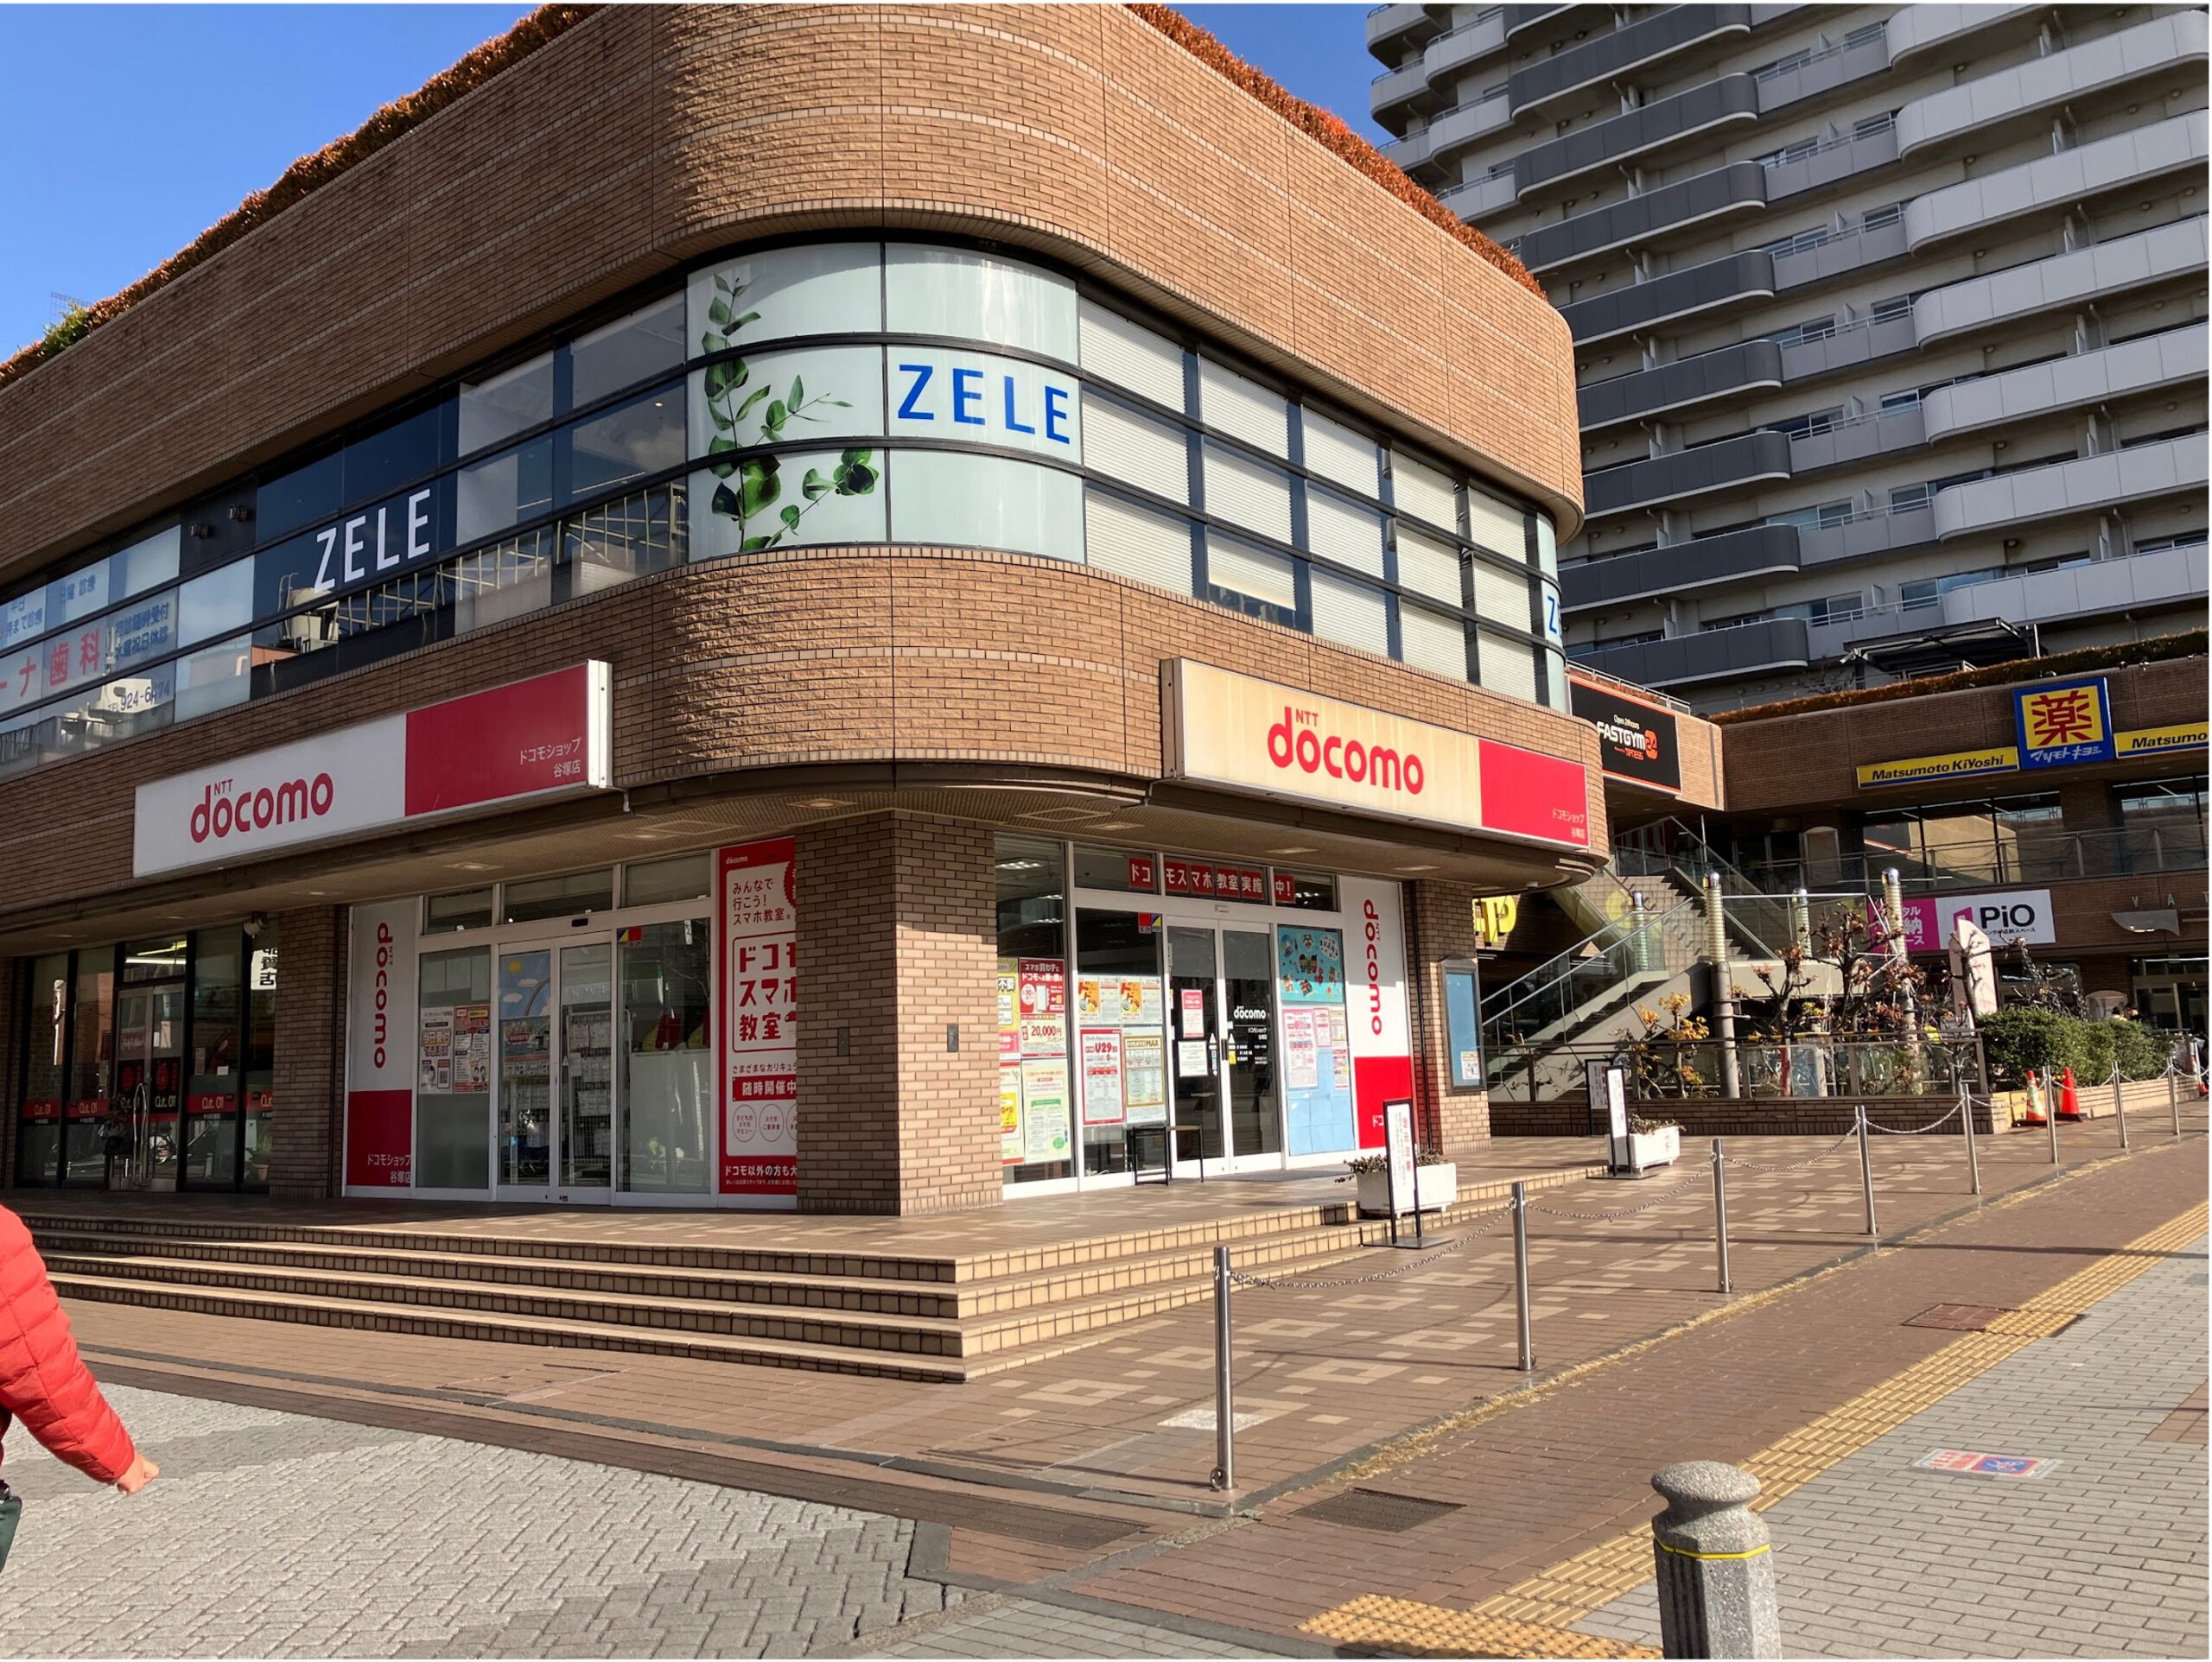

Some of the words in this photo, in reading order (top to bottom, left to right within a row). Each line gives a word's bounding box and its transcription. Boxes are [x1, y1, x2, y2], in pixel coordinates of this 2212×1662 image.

[896, 363, 1071, 446] ZELE
[314, 488, 430, 593] ZELE
[1295, 707, 1319, 727] NTT
[2031, 690, 2094, 746] 薬
[519, 735, 582, 765] ドコモショップ
[1267, 706, 1424, 795] docomo
[2132, 733, 2208, 749] Matsumo
[2030, 745, 2102, 764] マツモトキヨシ
[553, 758, 582, 778] 谷塚店
[1872, 763, 1950, 781] Matsumoto
[1952, 754, 2005, 771] KiYoshi
[213, 778, 233, 796] NTT
[190, 772, 334, 843] docomo
[726, 856, 748, 865] docomo
[733, 878, 774, 895] みんなで
[1980, 904, 2035, 929] PiO
[1363, 898, 1382, 1036] docomo
[374, 922, 393, 1069] docomo
[1233, 1005, 1267, 1019] docomo
[740, 1010, 781, 1042] 教室
[741, 1079, 797, 1096] 随時開催中
[367, 1153, 411, 1166] ドコモショップ
[725, 1164, 798, 1177] ドコモ以外の方も大
